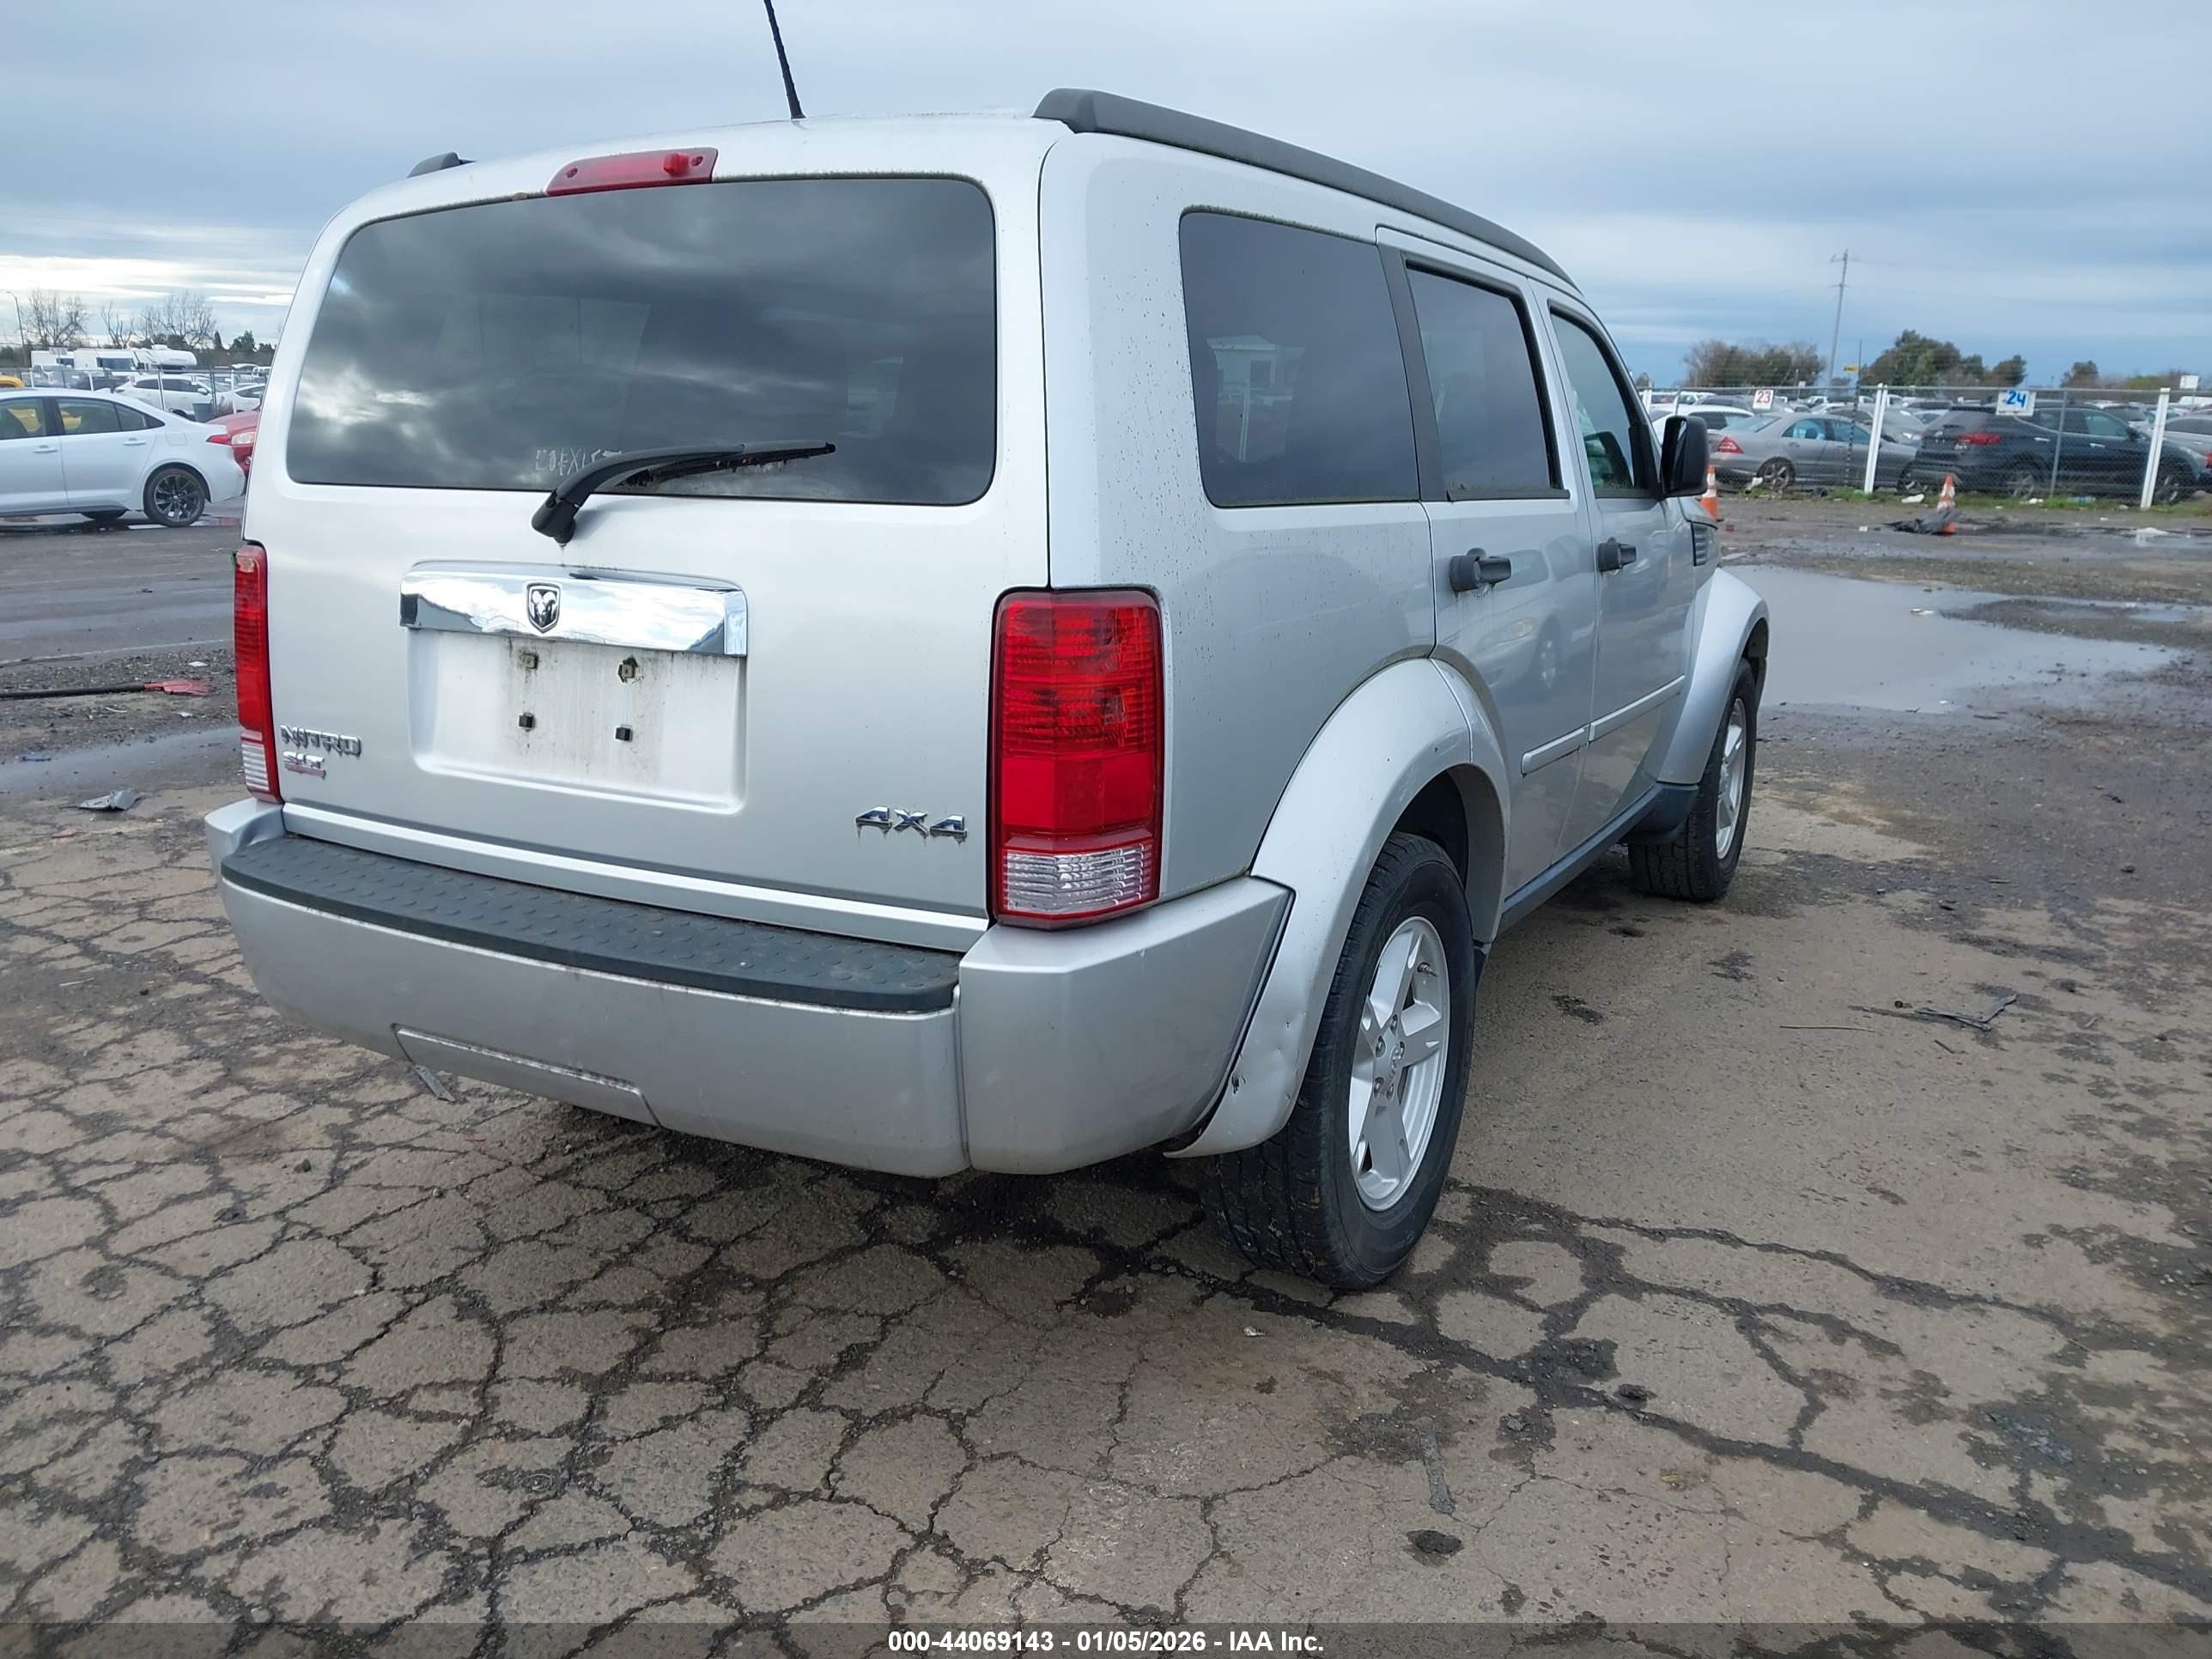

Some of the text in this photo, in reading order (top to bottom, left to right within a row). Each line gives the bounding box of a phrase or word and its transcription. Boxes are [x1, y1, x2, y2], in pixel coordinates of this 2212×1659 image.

[1756, 391, 1771, 404] 23
[2006, 391, 2027, 408] 24
[280, 724, 362, 757] NITRO
